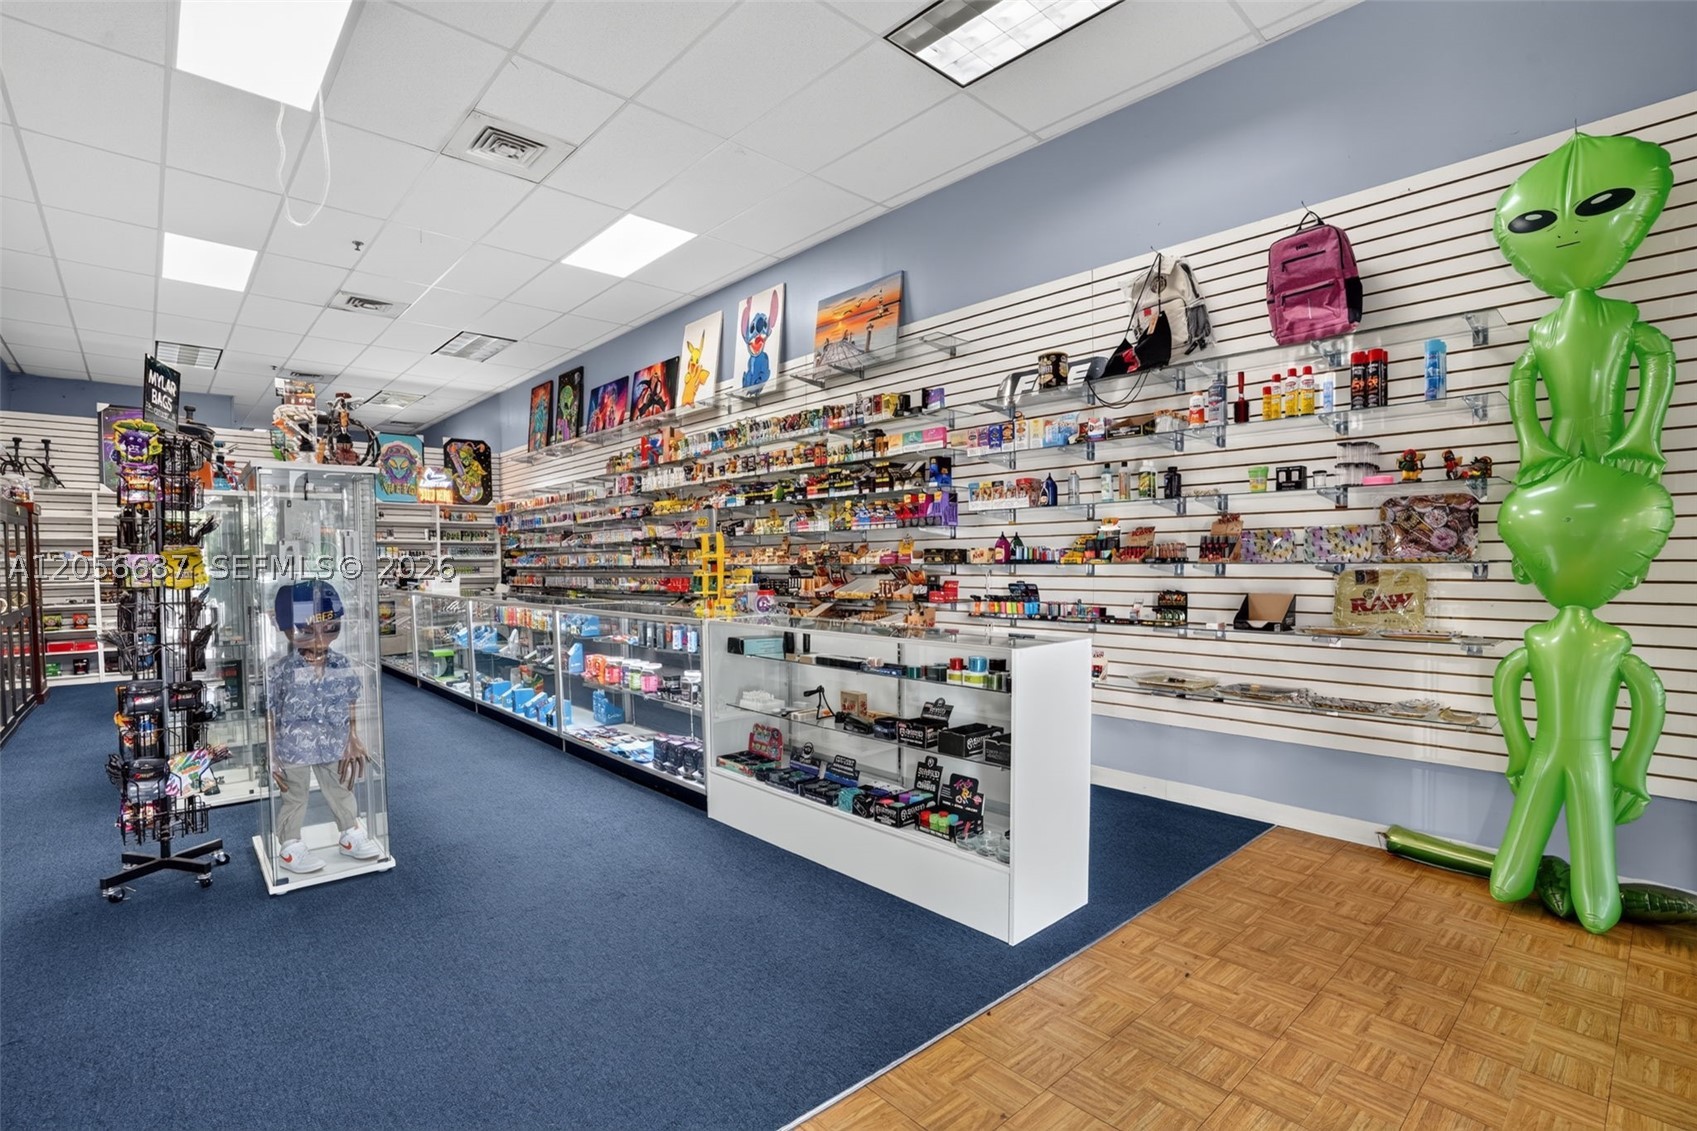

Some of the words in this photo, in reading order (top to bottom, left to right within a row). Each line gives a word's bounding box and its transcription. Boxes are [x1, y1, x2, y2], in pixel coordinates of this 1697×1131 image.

[148, 369, 177, 397] MYLAR
[151, 388, 173, 412] BAGS
[1349, 592, 1414, 613] RAW
